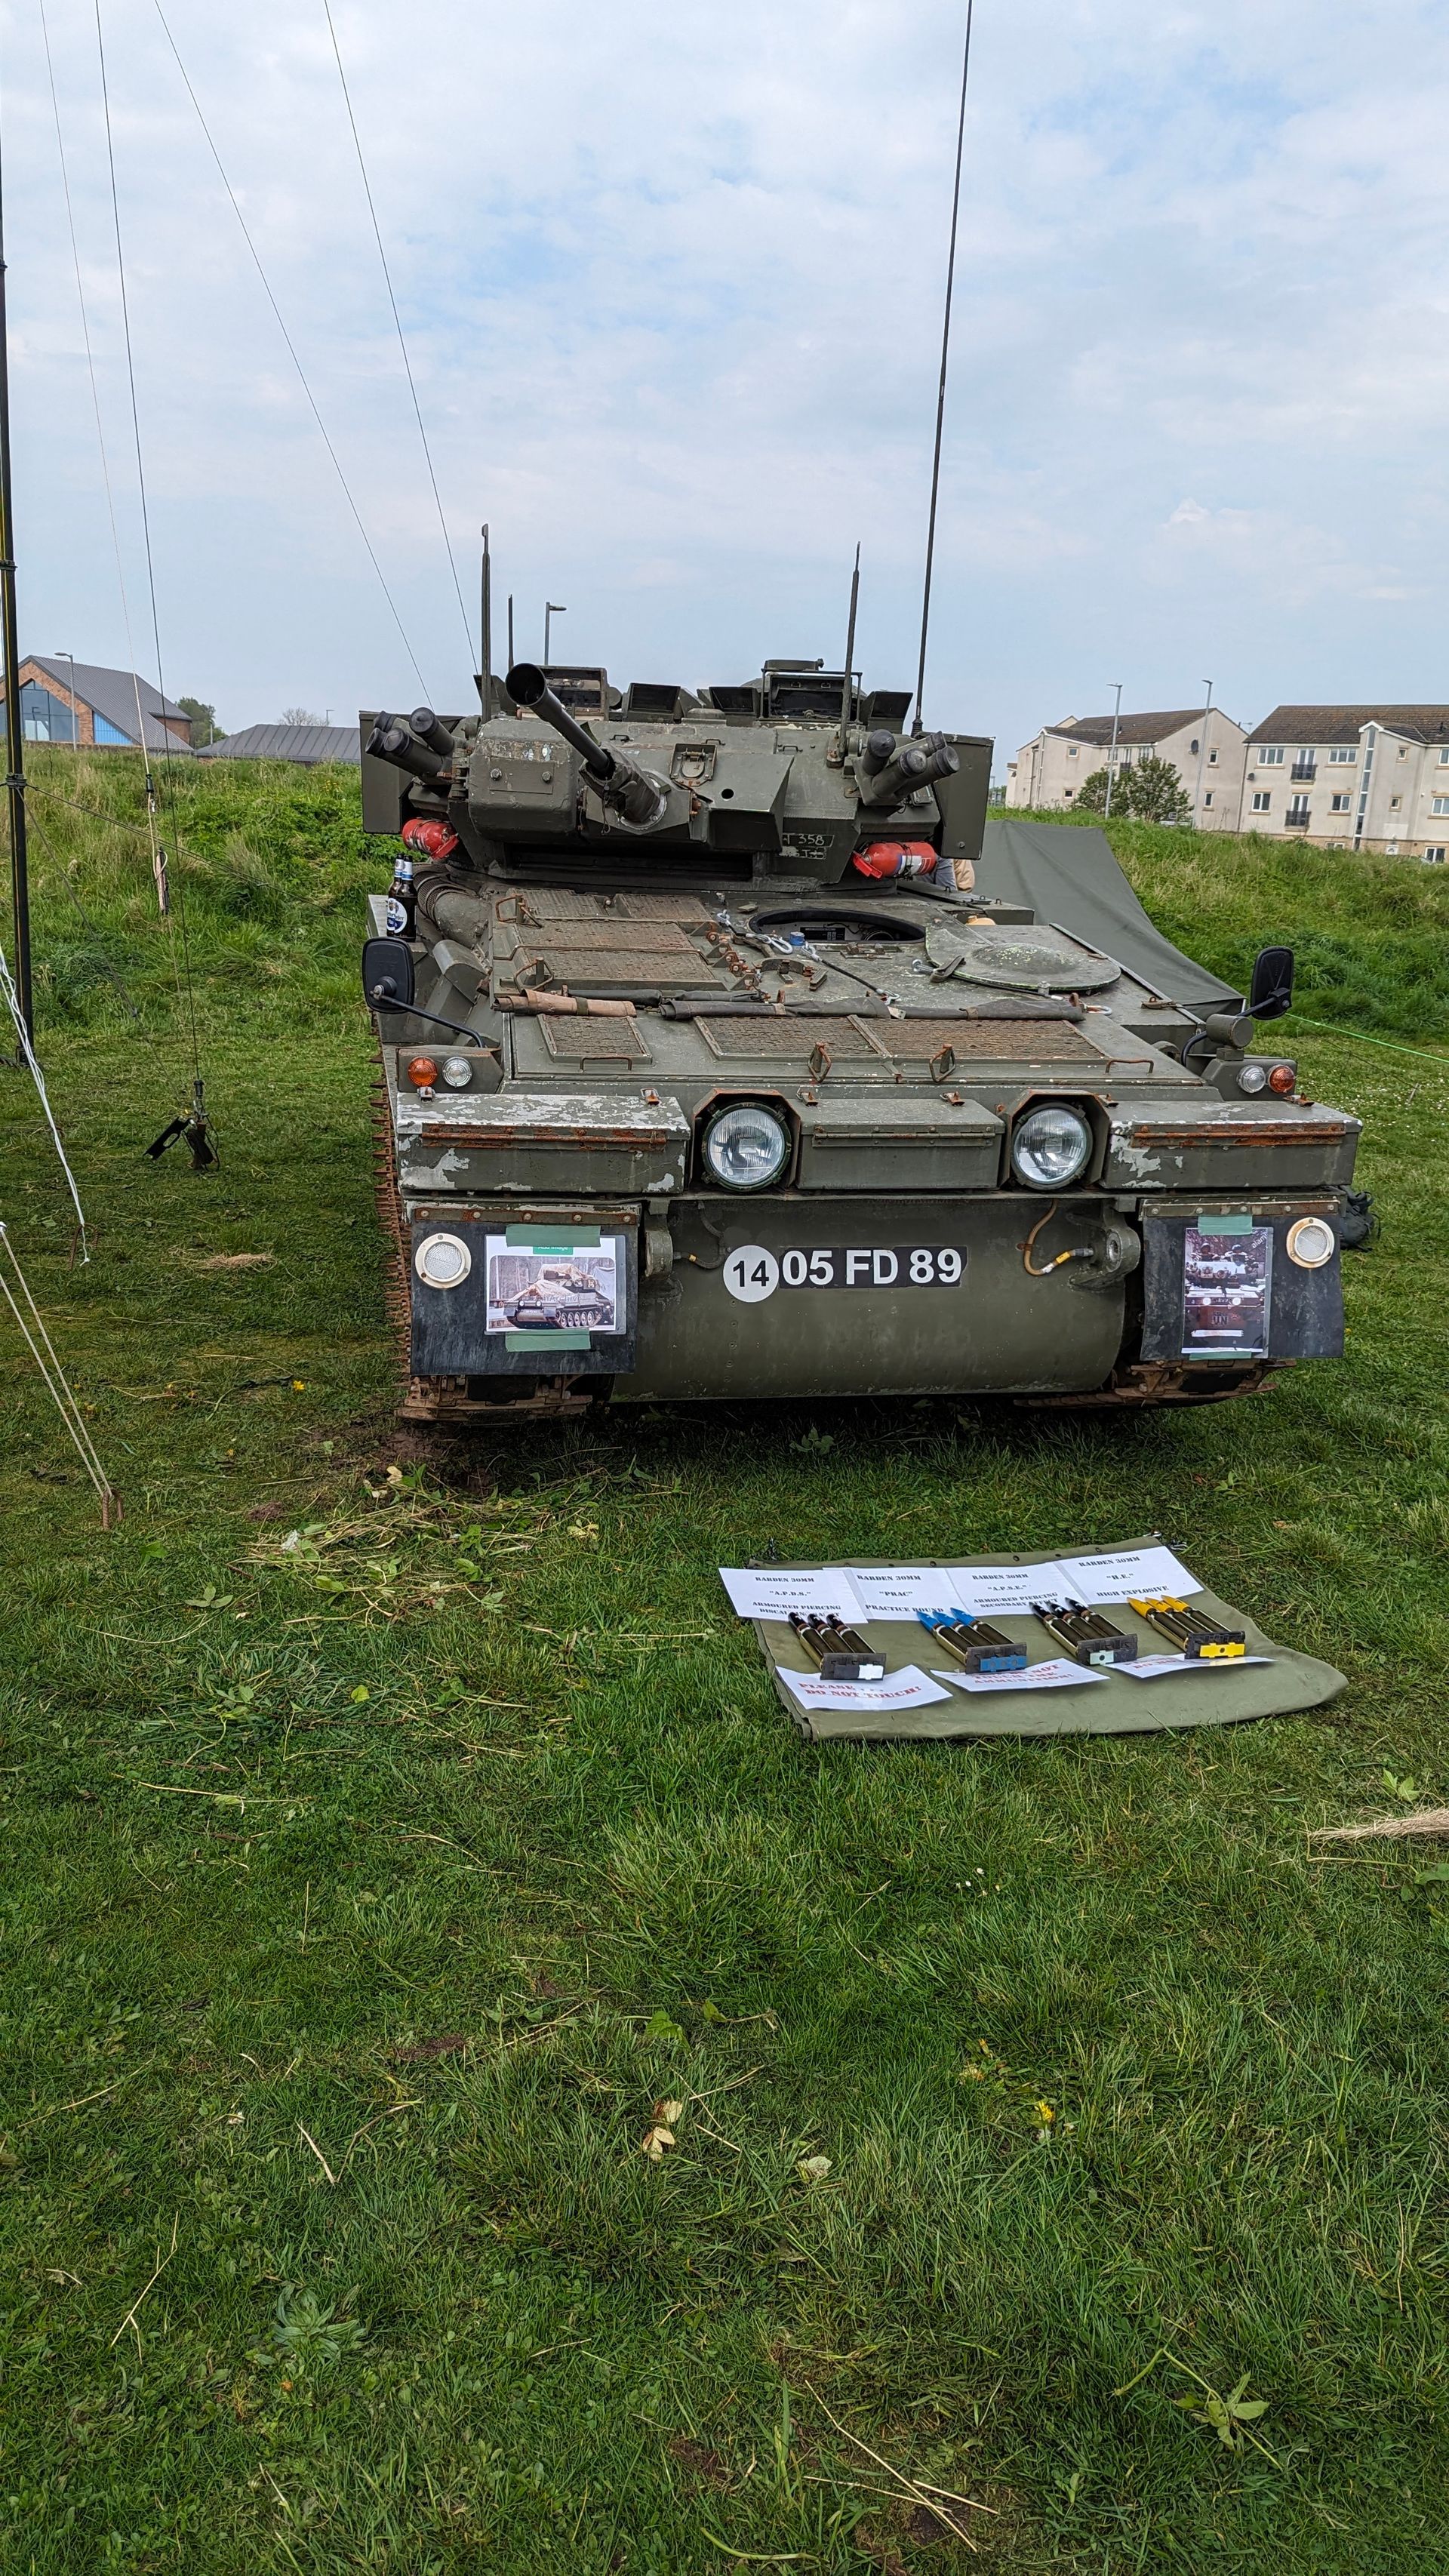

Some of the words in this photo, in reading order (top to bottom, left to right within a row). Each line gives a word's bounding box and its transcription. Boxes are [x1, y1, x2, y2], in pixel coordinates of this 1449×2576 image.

[798, 833, 826, 845] 358
[1252, 1233, 1268, 1248] alam
[782, 1250, 834, 1285] 05
[846, 1249, 898, 1285] FD
[909, 1248, 961, 1284] 89
[732, 1260, 770, 1288] 14
[1121, 1585, 1170, 1596] EXPLOSIVE
[1019, 1592, 1058, 1601] PIERCING
[752, 1601, 799, 1609] ARMOURED
[864, 1604, 911, 1612] PRACTICE
[798, 1682, 856, 1691] PLEASE
[863, 1685, 922, 1698] TOUCH!
